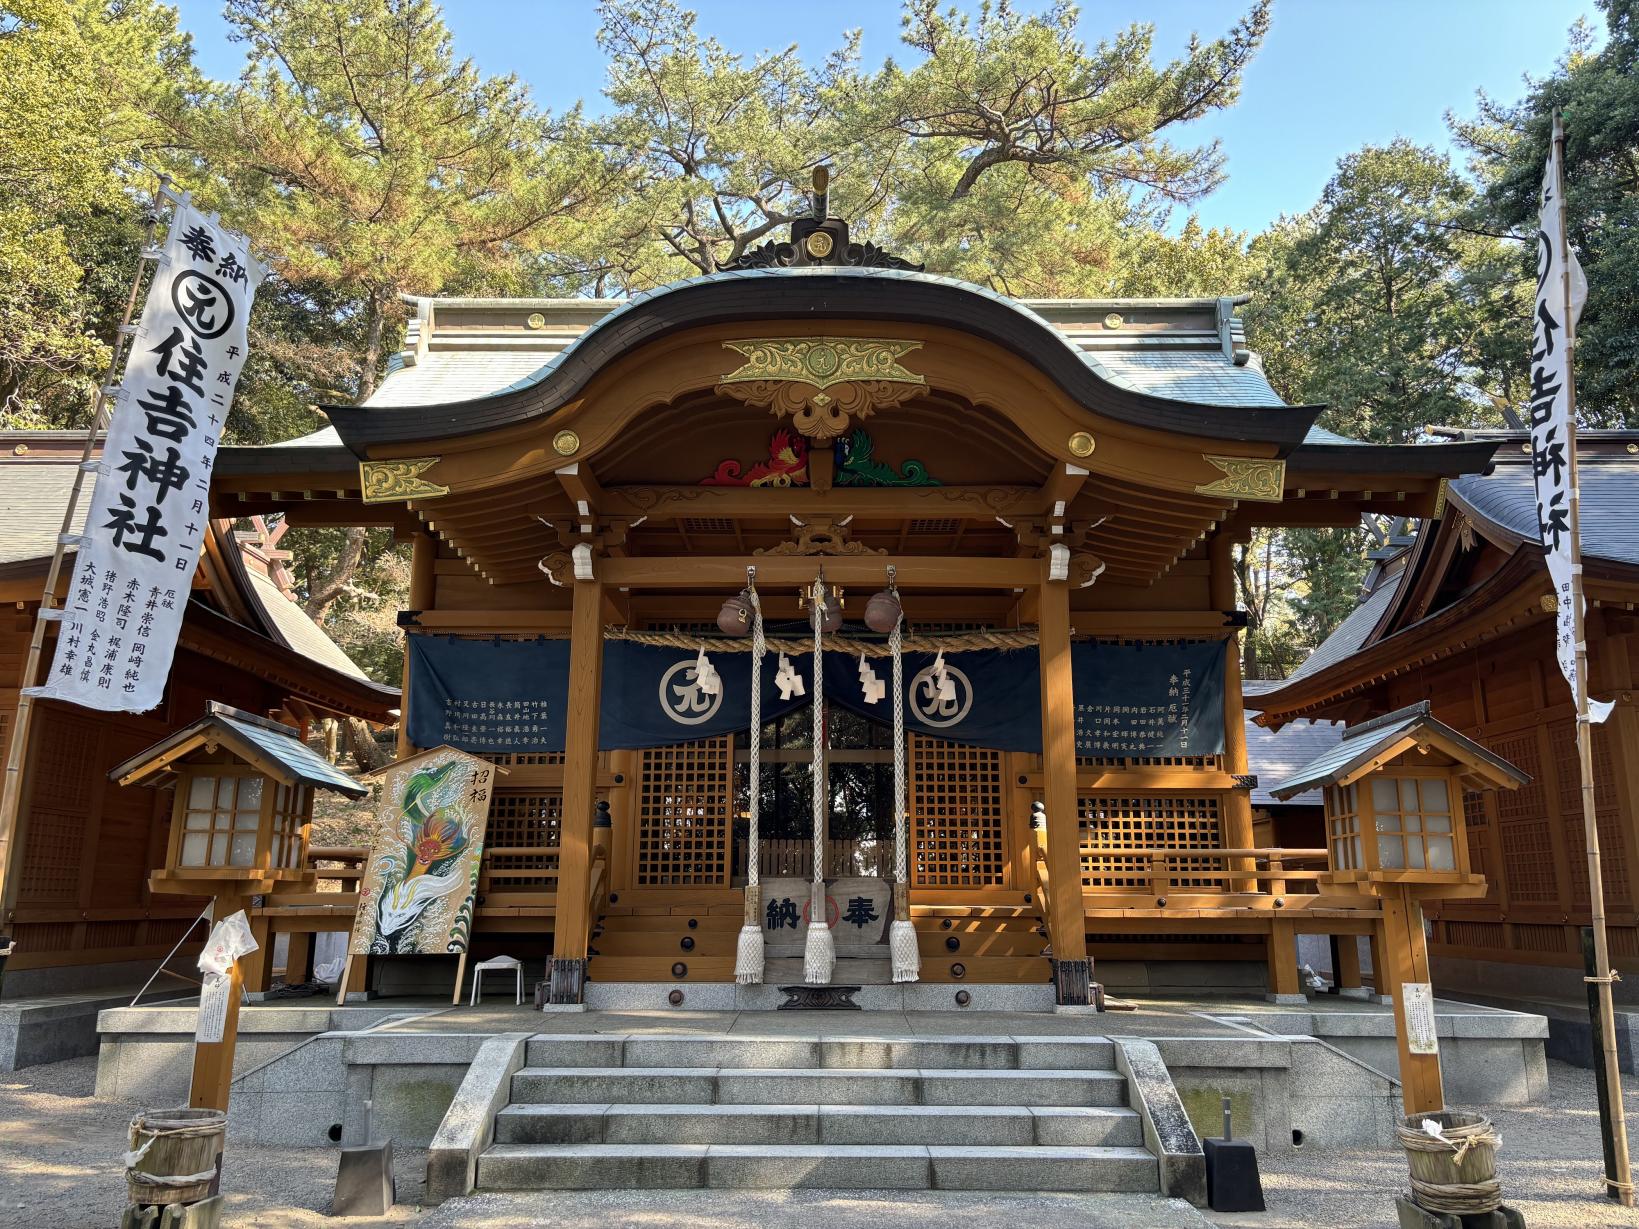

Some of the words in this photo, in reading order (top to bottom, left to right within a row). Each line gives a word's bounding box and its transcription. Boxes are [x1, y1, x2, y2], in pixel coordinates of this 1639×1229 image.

[176, 225, 249, 293] 奉納
[101, 326, 209, 564] 住吉神社
[174, 345, 241, 573] 平成二十四年二月十一日
[74, 561, 97, 612] 大城憲一
[95, 570, 118, 623] 猪野浩昭
[115, 577, 141, 630] 赤木隆司
[137, 585, 163, 638] 青井崇信
[59, 621, 83, 676] 川村幸雄
[98, 635, 121, 689] 梶浦康則
[1168, 674, 1179, 697] 奉納
[469, 769, 490, 803] 招福
[766, 897, 801, 930] 納
[841, 896, 880, 929] 奉
